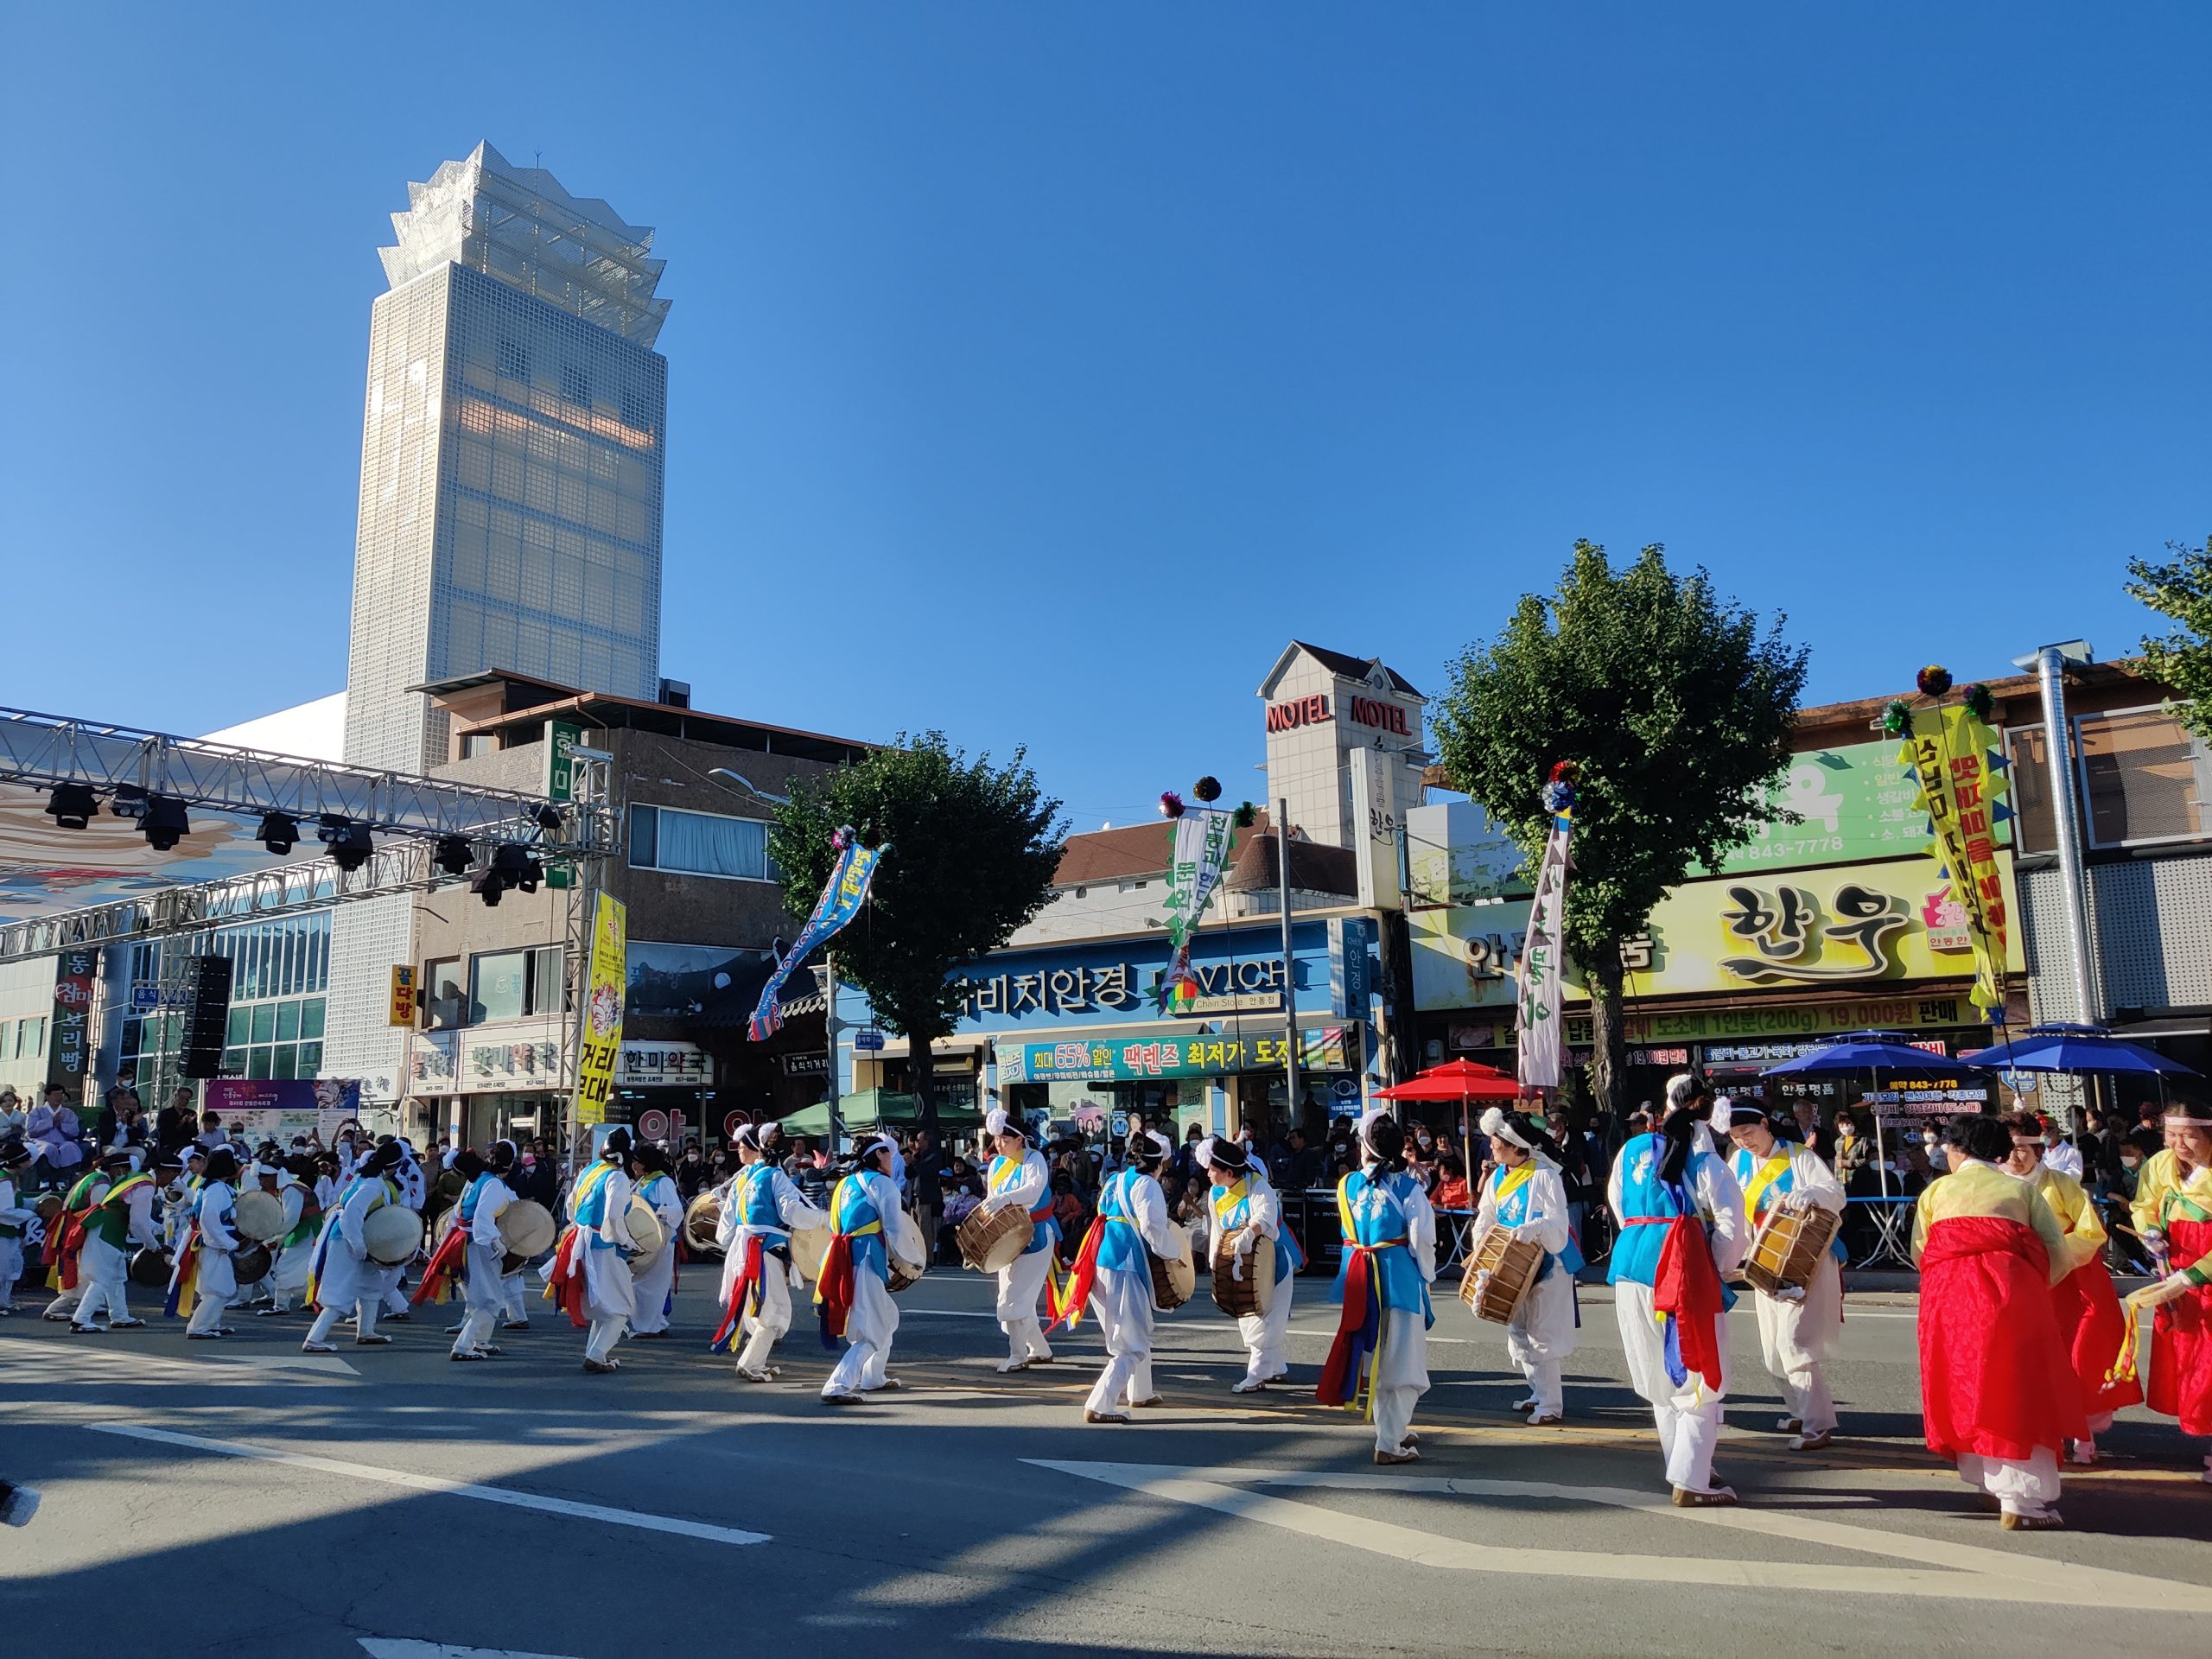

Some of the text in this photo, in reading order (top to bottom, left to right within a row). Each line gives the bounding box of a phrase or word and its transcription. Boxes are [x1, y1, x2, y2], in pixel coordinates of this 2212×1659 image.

[1266, 693, 1331, 733] MOTEL
[1351, 695, 1413, 736] MOTEL
[1877, 788, 1916, 805] 생갈비
[1749, 836, 1844, 861] 843-7778
[1721, 884, 1908, 982] 한우
[1350, 950, 1362, 989] 안경
[1249, 995, 1274, 1006] 안동점
[1657, 1014, 1706, 1036] 도소매
[1713, 1007, 1820, 1033] 1인분(200g)
[1827, 1001, 1914, 1029] 19,000원
[1917, 998, 1958, 1023] 판매
[60, 1012, 85, 1073] 보리빵
[473, 1042, 556, 1076] 한미약국
[582, 1042, 617, 1072] 거리
[1034, 1051, 1053, 1069] 최대
[1054, 1041, 1091, 1069] 65%
[1091, 1048, 1113, 1066] 할인
[1123, 1042, 1180, 1076] 팩렌즈
[1187, 1039, 1246, 1070] 최저가
[626, 1051, 707, 1073] 한미약국
[1782, 1083, 1835, 1096] 안동명품
[1890, 1081, 1908, 1090] 예약
